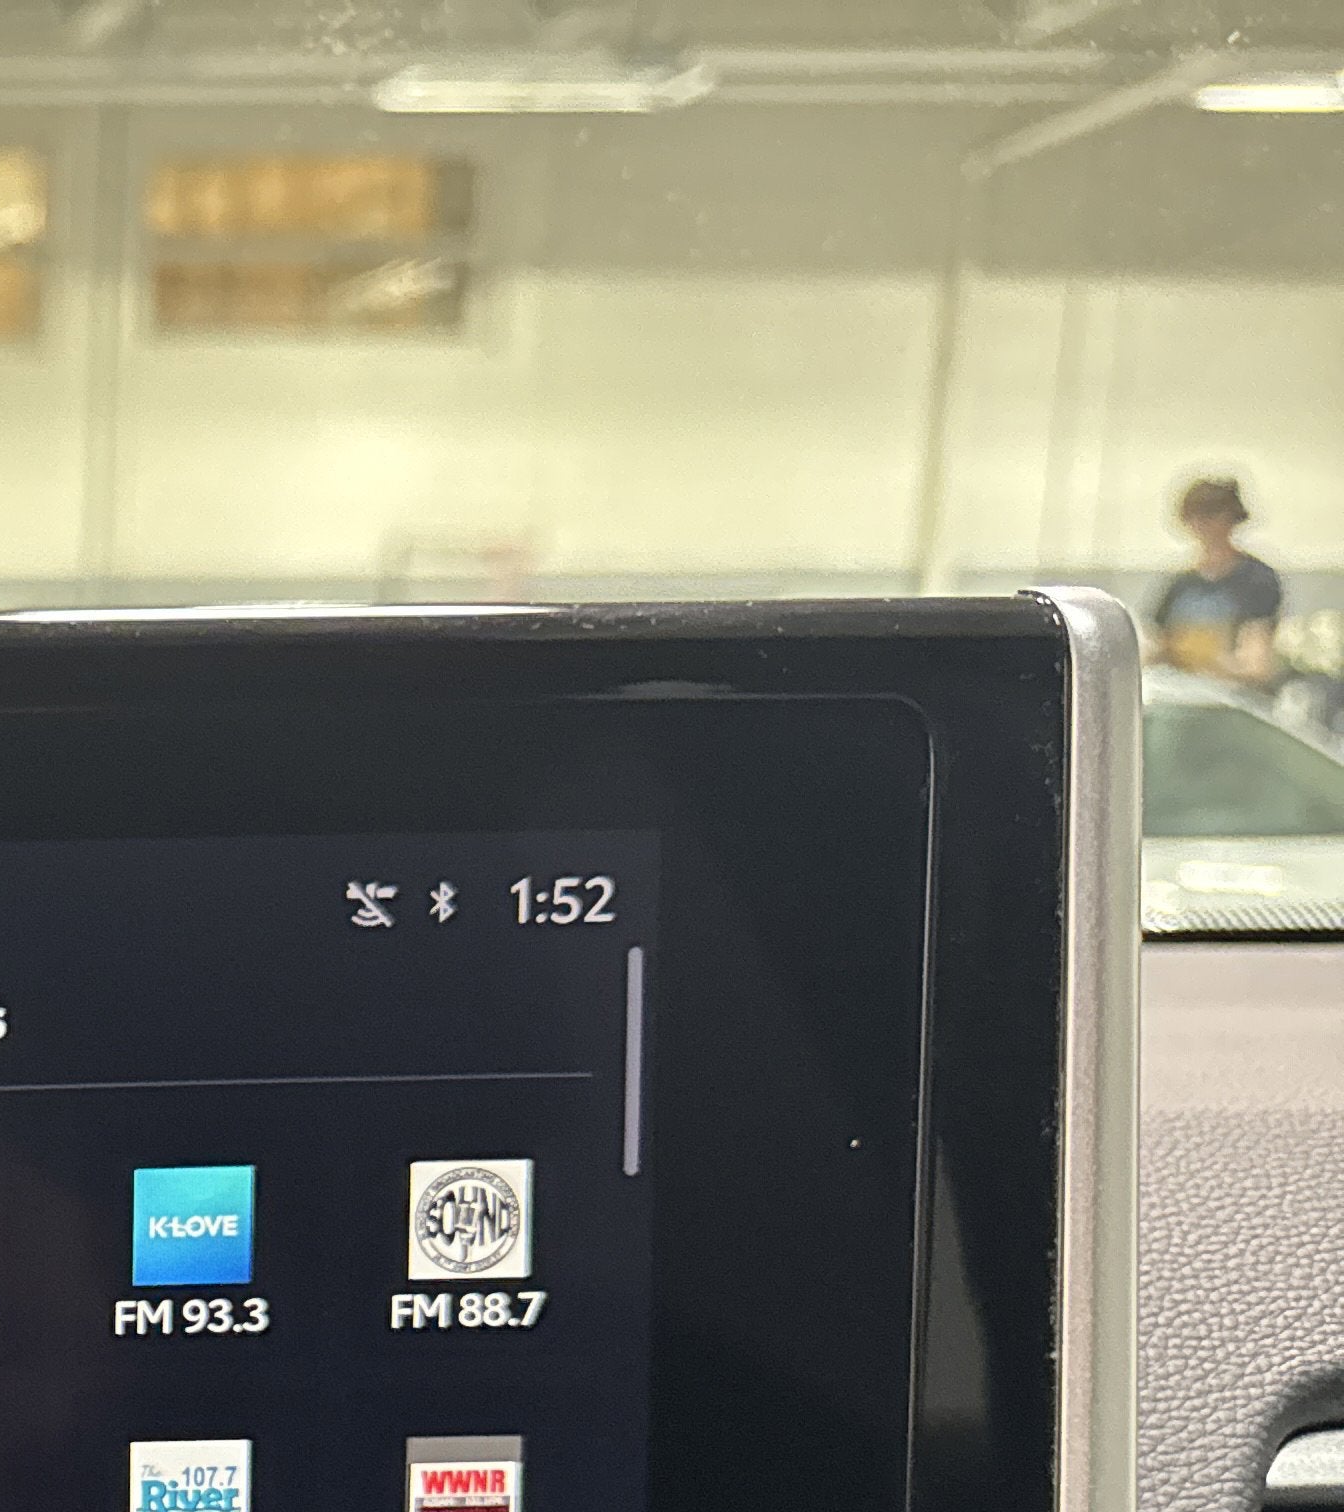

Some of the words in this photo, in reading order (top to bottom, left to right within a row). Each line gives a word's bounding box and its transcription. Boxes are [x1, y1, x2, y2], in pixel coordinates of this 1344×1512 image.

[510, 876, 615, 924] 1:52
[114, 1299, 173, 1336] FM
[182, 1297, 269, 1334] 93.3
[391, 1293, 452, 1329] FM
[458, 1291, 546, 1328] 88.7
[182, 1466, 237, 1487] 107.7
[421, 1469, 506, 1494] WWNR
